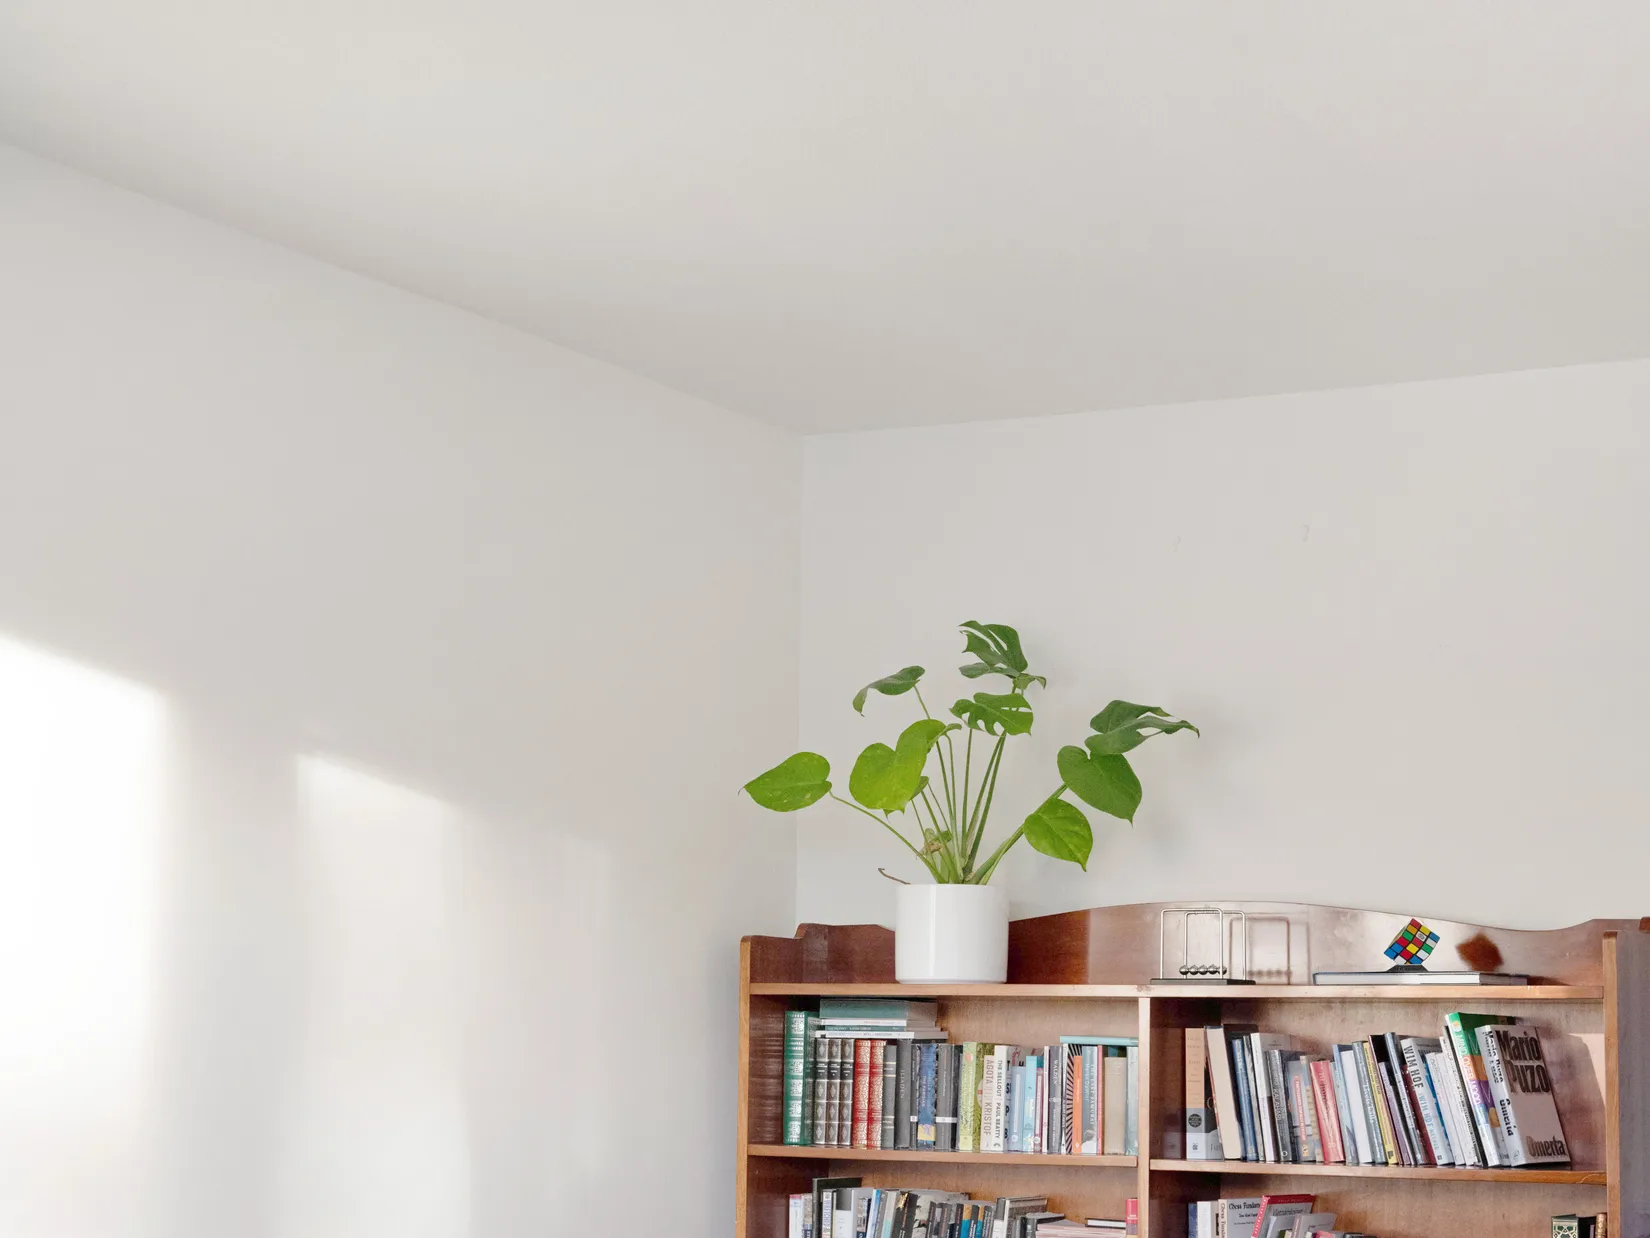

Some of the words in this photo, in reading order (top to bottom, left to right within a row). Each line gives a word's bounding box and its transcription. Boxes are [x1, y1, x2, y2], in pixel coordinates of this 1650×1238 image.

[1499, 1030, 1542, 1061] Mario
[986, 1059, 994, 1085] AGOTA
[1403, 1045, 1418, 1067] WIM
[1411, 1068, 1424, 1089] HOF
[1456, 1033, 1468, 1056] MIND
[1463, 1056, 1475, 1080] OVER
[1471, 1079, 1481, 1105] MOOD
[1506, 1059, 1551, 1094] Puzo
[983, 1102, 992, 1136] KRISTOF
